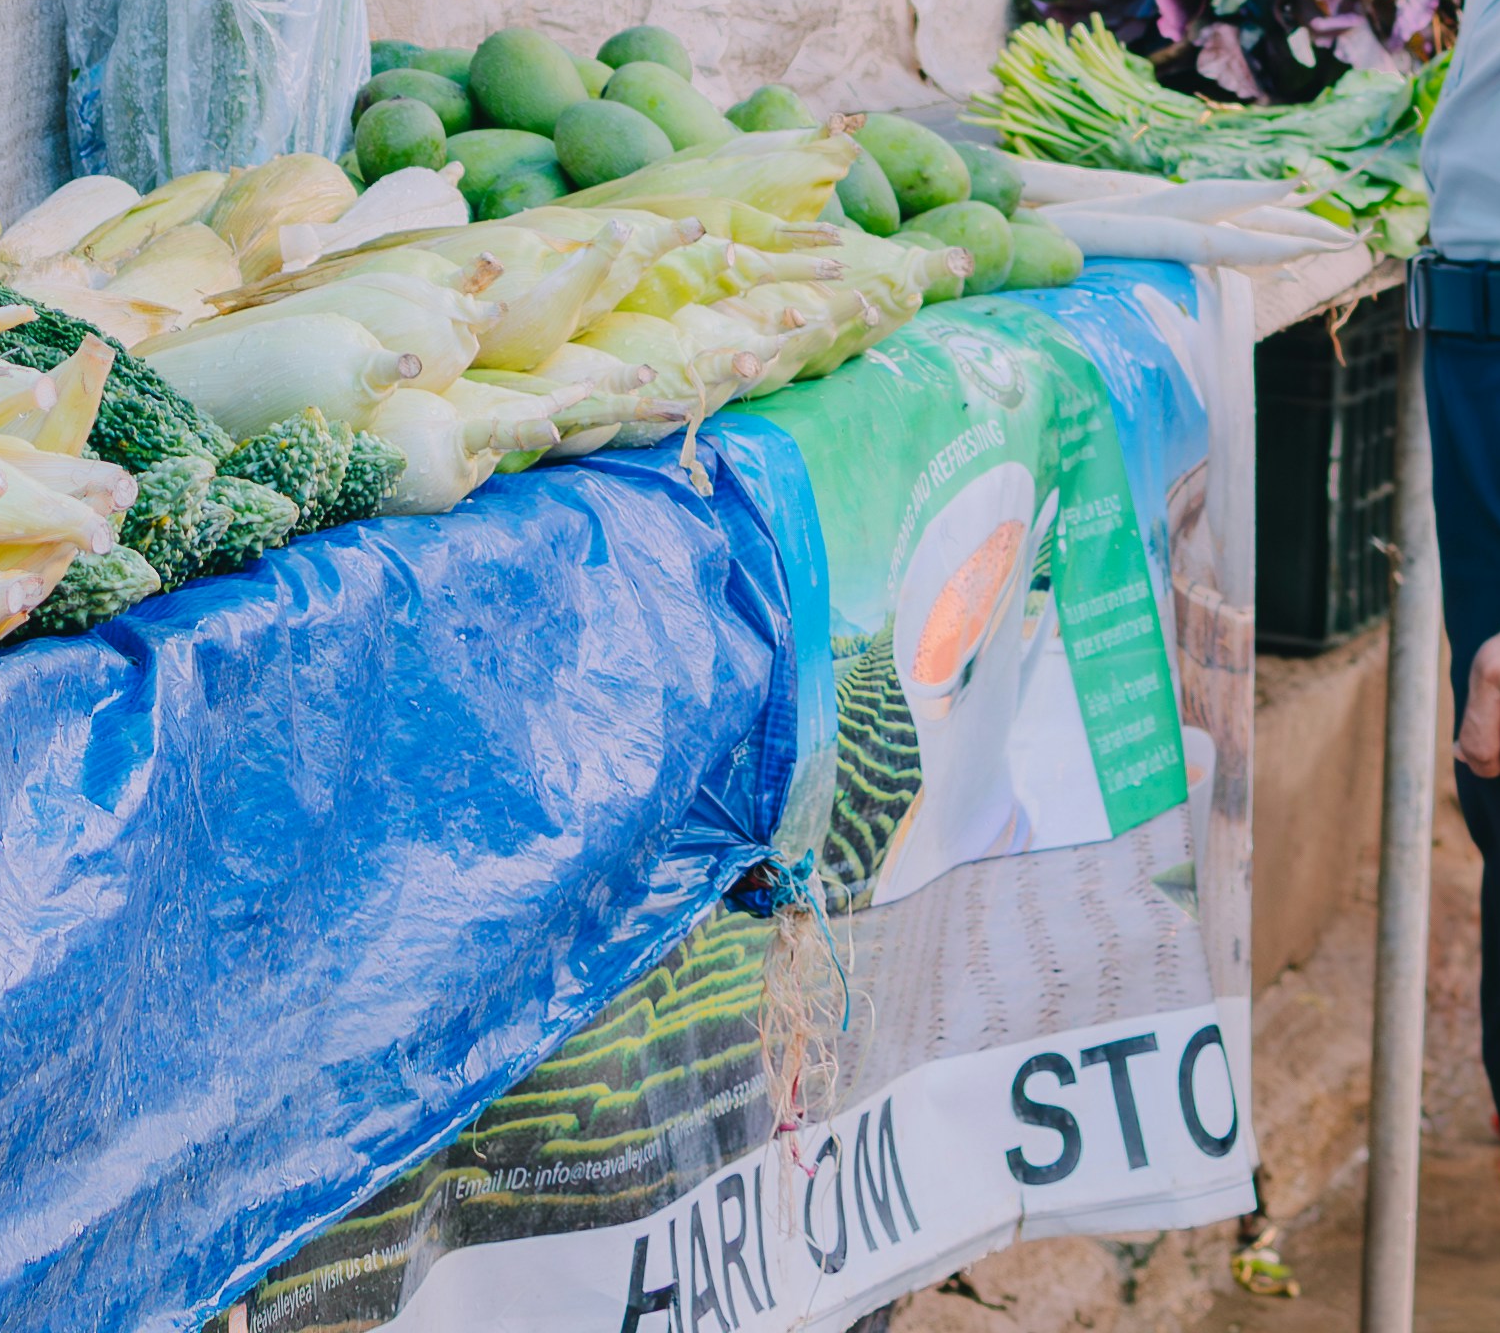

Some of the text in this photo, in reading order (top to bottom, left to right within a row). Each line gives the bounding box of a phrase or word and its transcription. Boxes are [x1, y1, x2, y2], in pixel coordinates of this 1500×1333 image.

[455, 1165, 503, 1200] Email
[505, 1167, 532, 1191] ID:
[534, 1136, 663, 1185] info@teavalley.com
[620, 1096, 920, 1333] HARI OM
[319, 1258, 344, 1293] Visit
[346, 1257, 361, 1280] us
[363, 1248, 378, 1273] at
